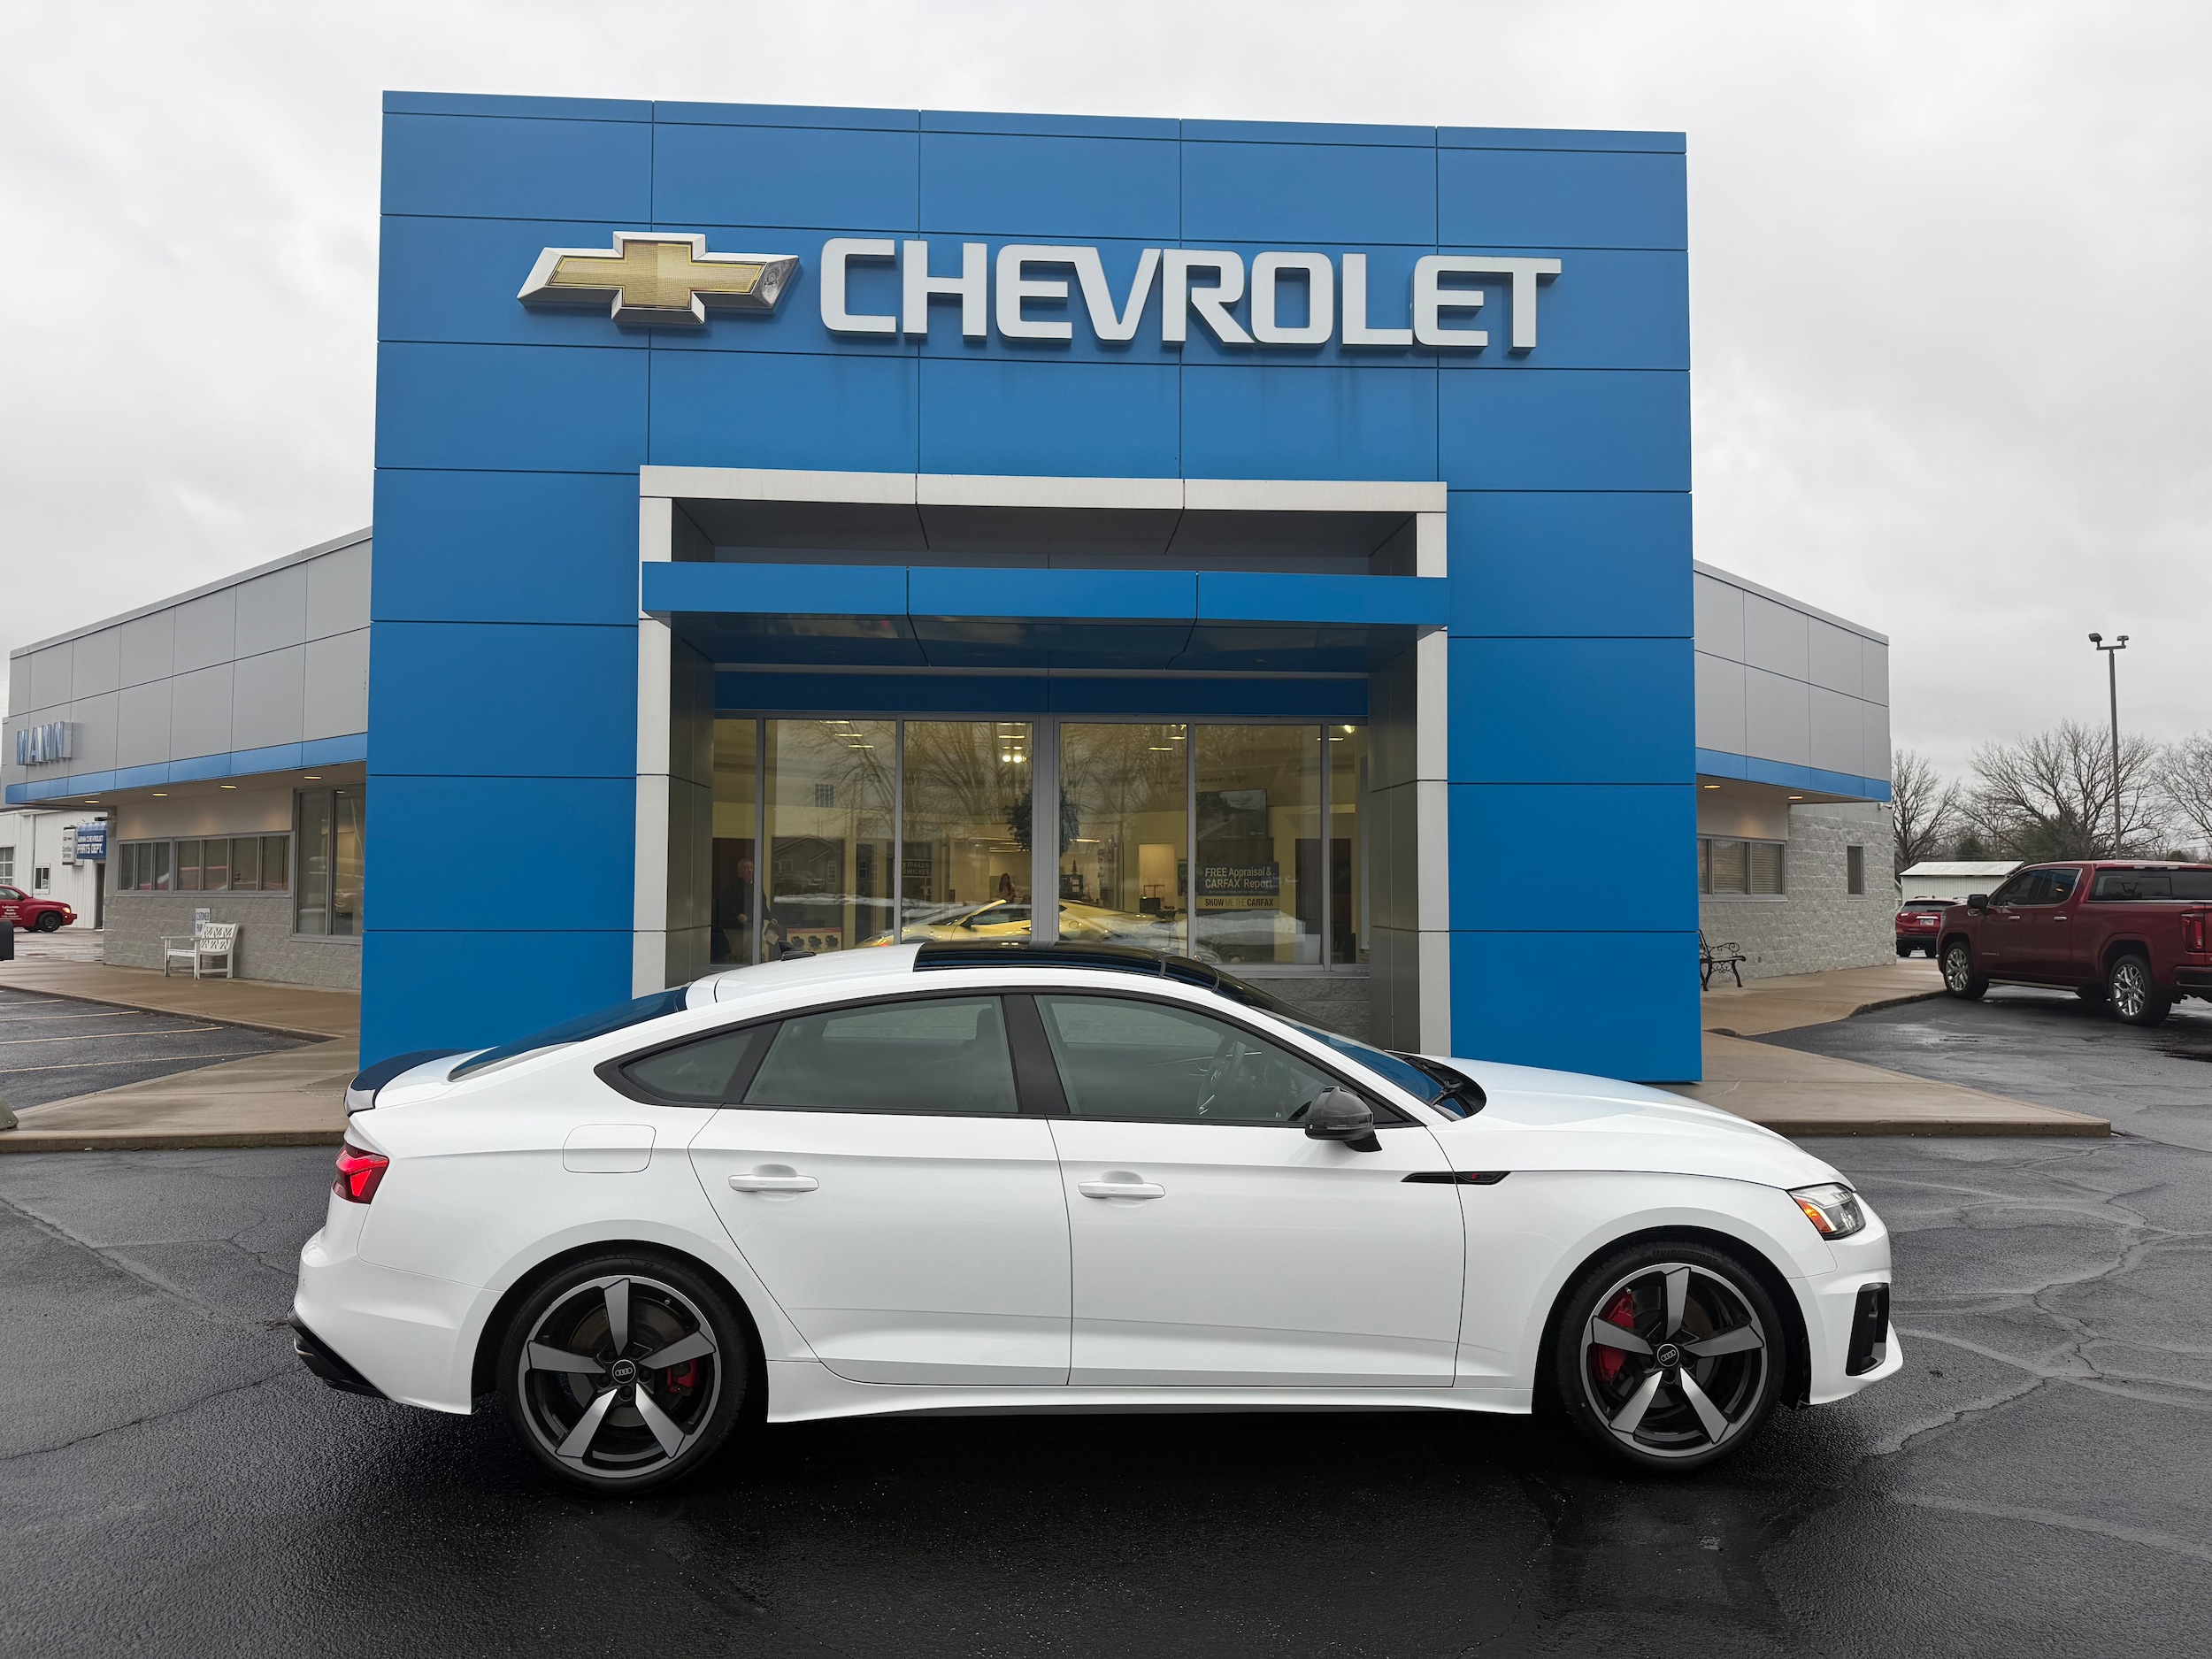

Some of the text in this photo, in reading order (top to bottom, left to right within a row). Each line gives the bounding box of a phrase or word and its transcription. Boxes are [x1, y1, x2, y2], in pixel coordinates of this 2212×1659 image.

[820, 235, 1562, 354] CHEVROLET
[16, 721, 69, 765] MANN
[77, 842, 104, 854] PARTS DEPT.
[1205, 866, 1272, 879] FREE Appraisal &
[1205, 879, 1273, 890] CARFAX Report
[1204, 898, 1225, 907] SHOW
[1225, 898, 1234, 907] ME
[1247, 898, 1274, 907] CARFAX
